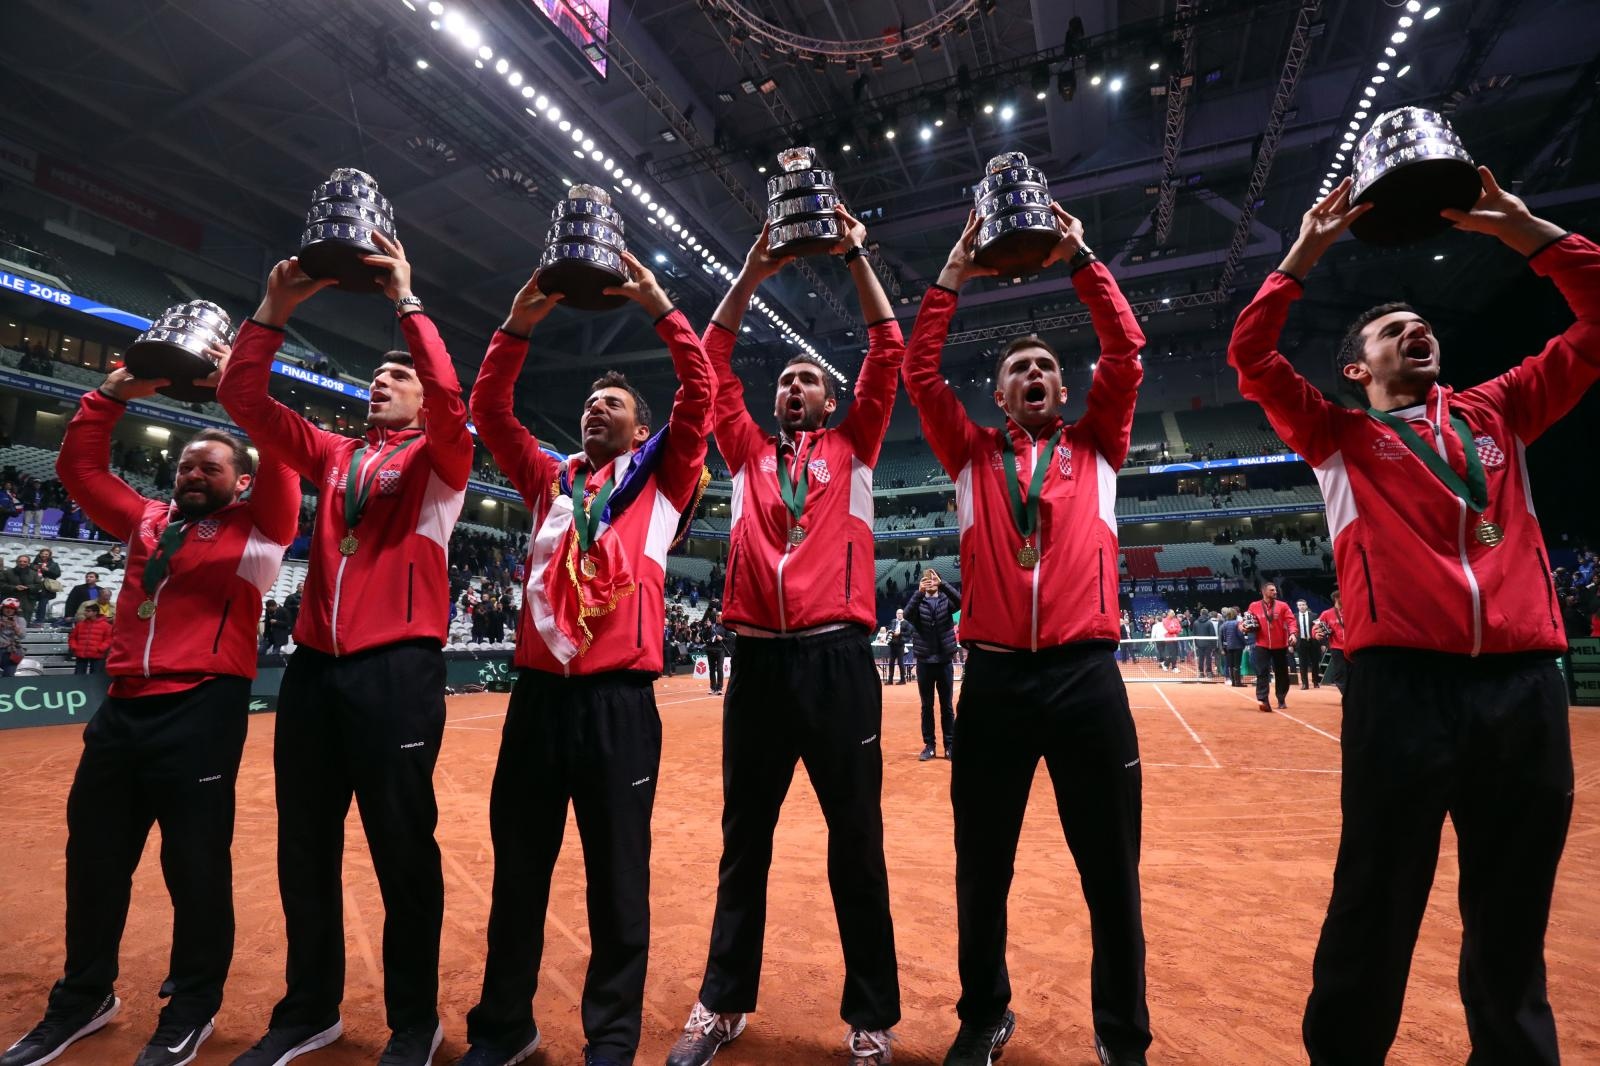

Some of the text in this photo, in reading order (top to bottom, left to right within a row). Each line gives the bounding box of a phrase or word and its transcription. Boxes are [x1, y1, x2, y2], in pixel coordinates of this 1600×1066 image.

[29, 283, 72, 305] 2018
[281, 364, 344, 391] FINALE 2018
[1237, 457, 1265, 466] FINALE
[1266, 455, 1286, 463] 2018
[401, 741, 425, 749] HEAD
[861, 734, 877, 745] HEAD
[199, 774, 222, 782] HEAD
